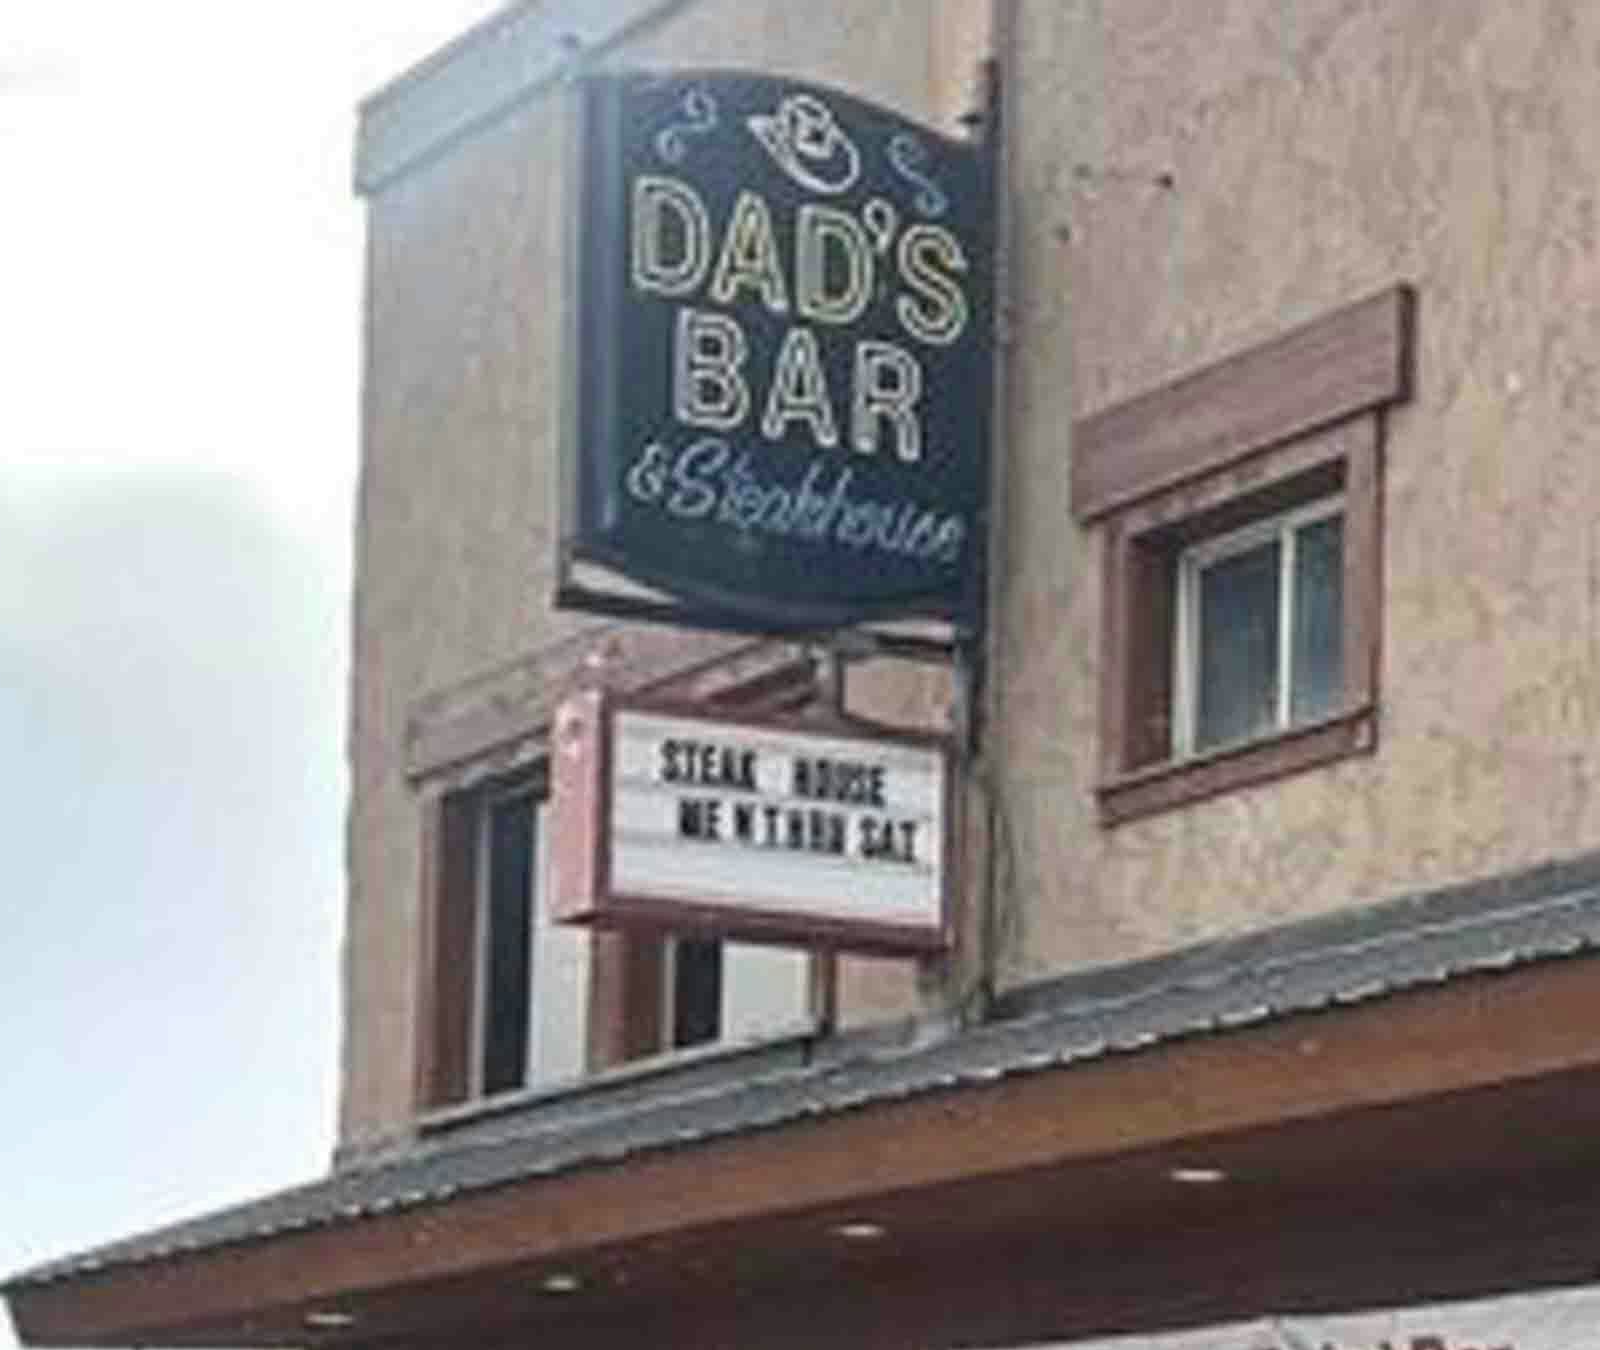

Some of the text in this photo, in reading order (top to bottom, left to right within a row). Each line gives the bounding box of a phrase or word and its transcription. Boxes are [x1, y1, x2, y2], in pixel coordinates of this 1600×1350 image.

[630, 173, 970, 345] DAD'S
[673, 307, 924, 462] BAR
[660, 738, 886, 808] STEAK HOUSE
[859, 815, 917, 865] SAT
